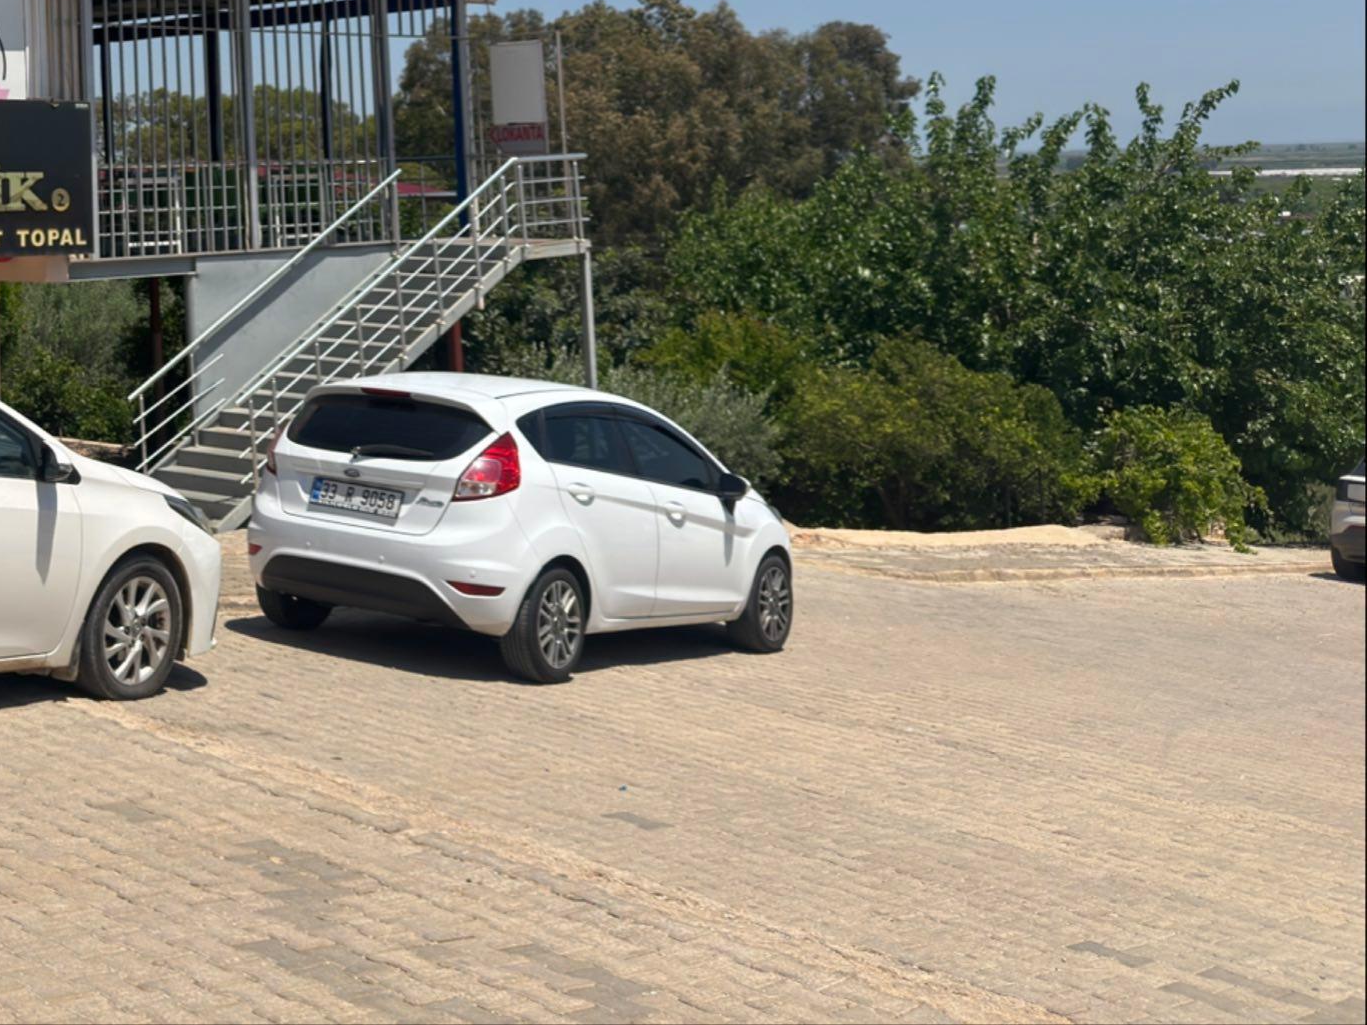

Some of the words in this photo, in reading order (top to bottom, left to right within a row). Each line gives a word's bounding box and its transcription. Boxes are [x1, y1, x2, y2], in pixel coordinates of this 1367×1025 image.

[16, 228, 88, 248] TOPAL
[321, 482, 338, 499] 33
[361, 489, 397, 510] 9058
